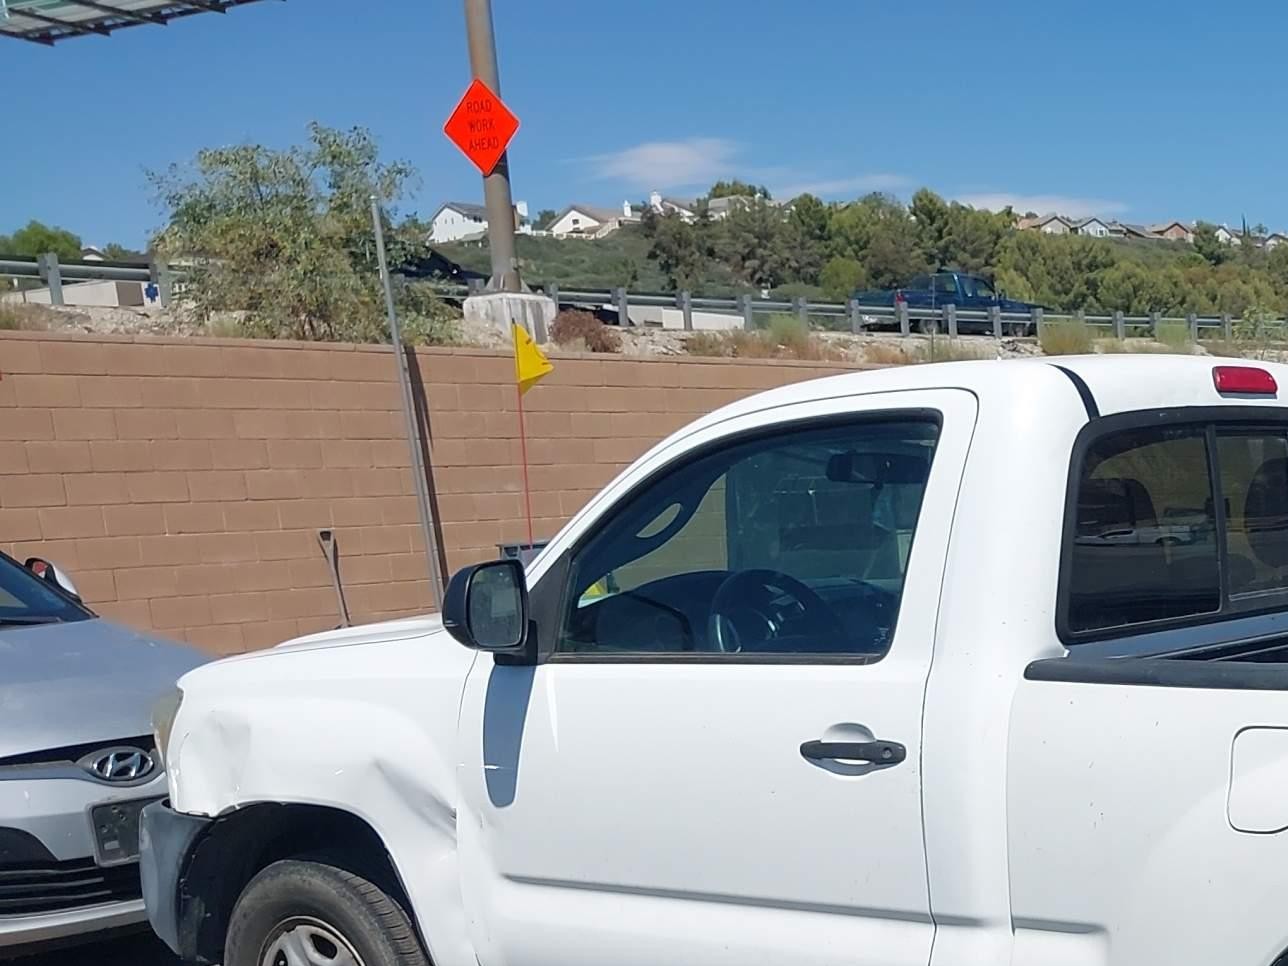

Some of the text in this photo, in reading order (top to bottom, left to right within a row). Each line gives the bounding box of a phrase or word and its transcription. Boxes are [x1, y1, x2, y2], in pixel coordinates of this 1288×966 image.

[467, 100, 492, 113] ROAD
[469, 118, 495, 132] WORK
[469, 137, 499, 151] AHEAD
